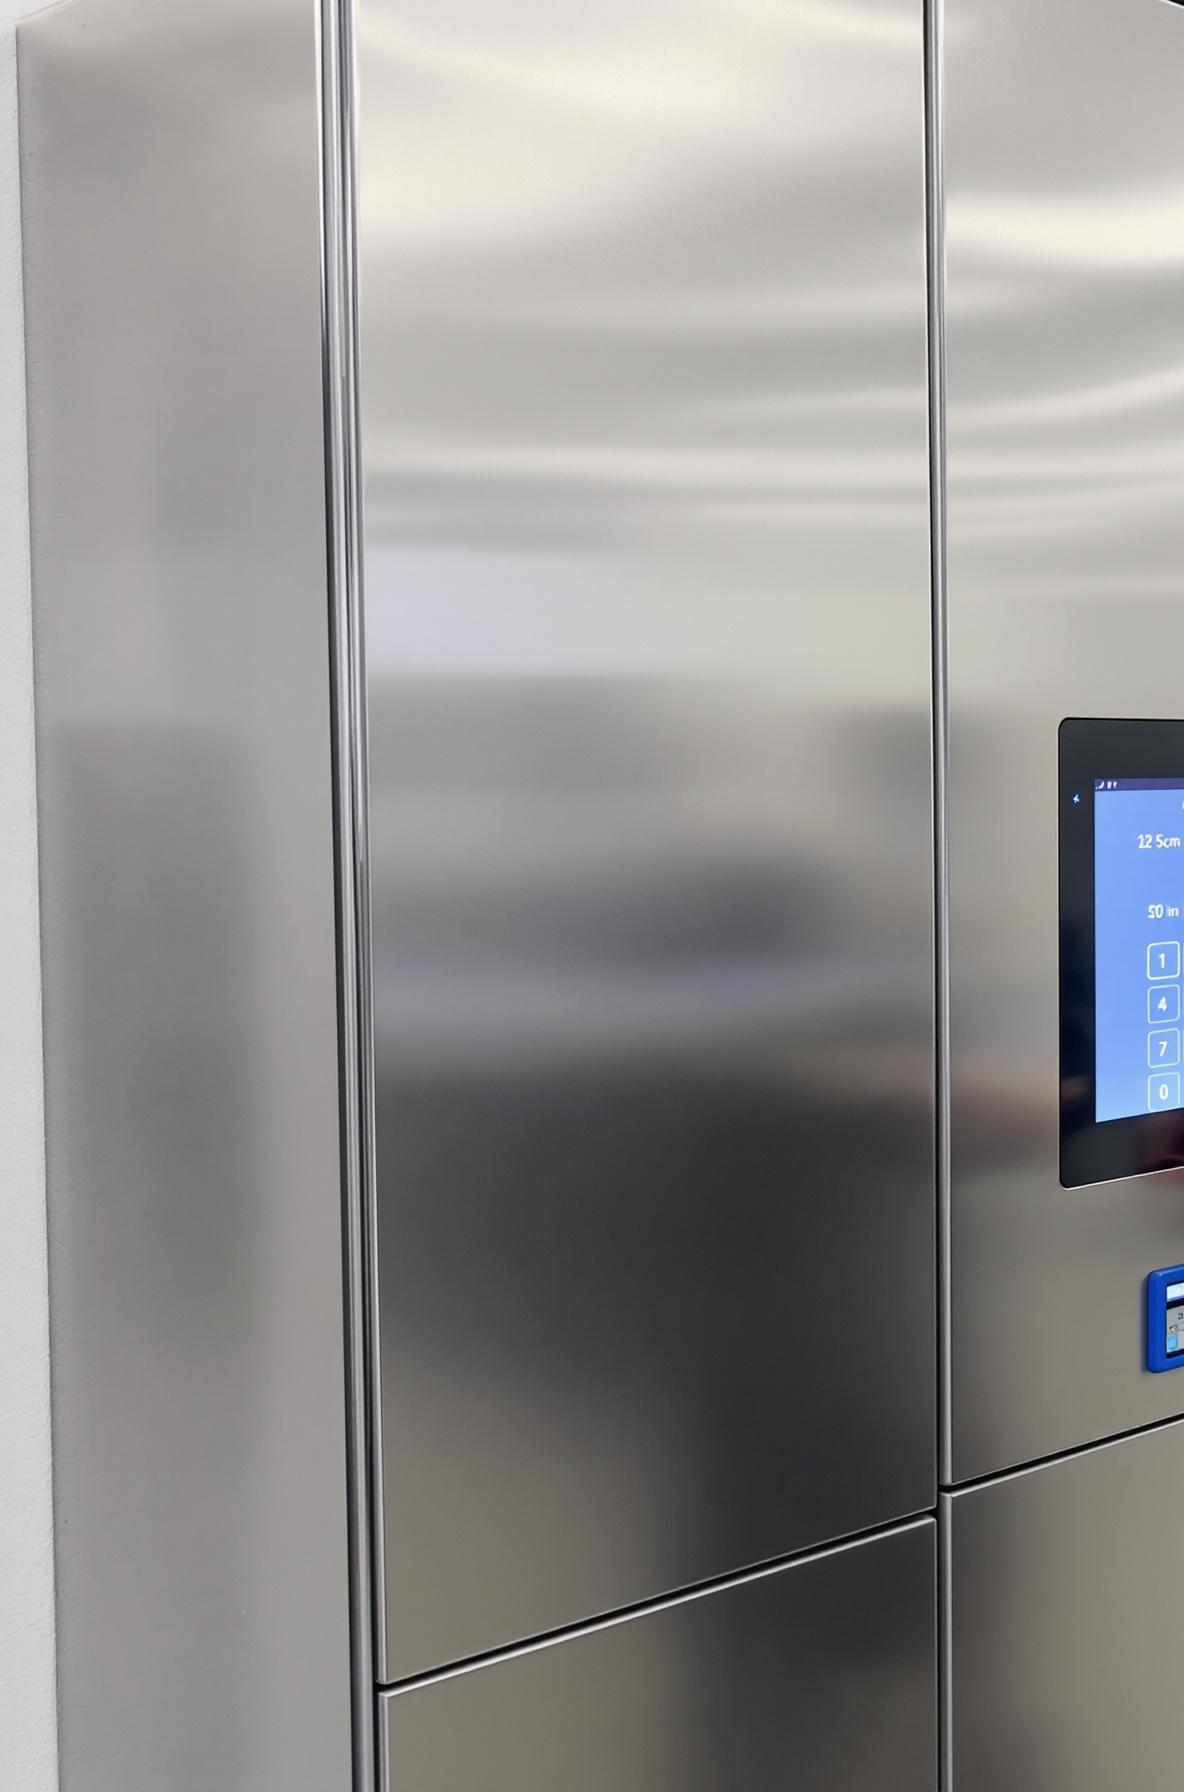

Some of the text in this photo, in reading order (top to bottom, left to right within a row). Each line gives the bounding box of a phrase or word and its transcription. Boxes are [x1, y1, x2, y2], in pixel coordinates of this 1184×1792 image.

[1157, 953, 1166, 969] 1
[1157, 996, 1168, 1012] 4
[1158, 1040, 1168, 1057] 7
[1159, 1083, 1169, 1101] 0
